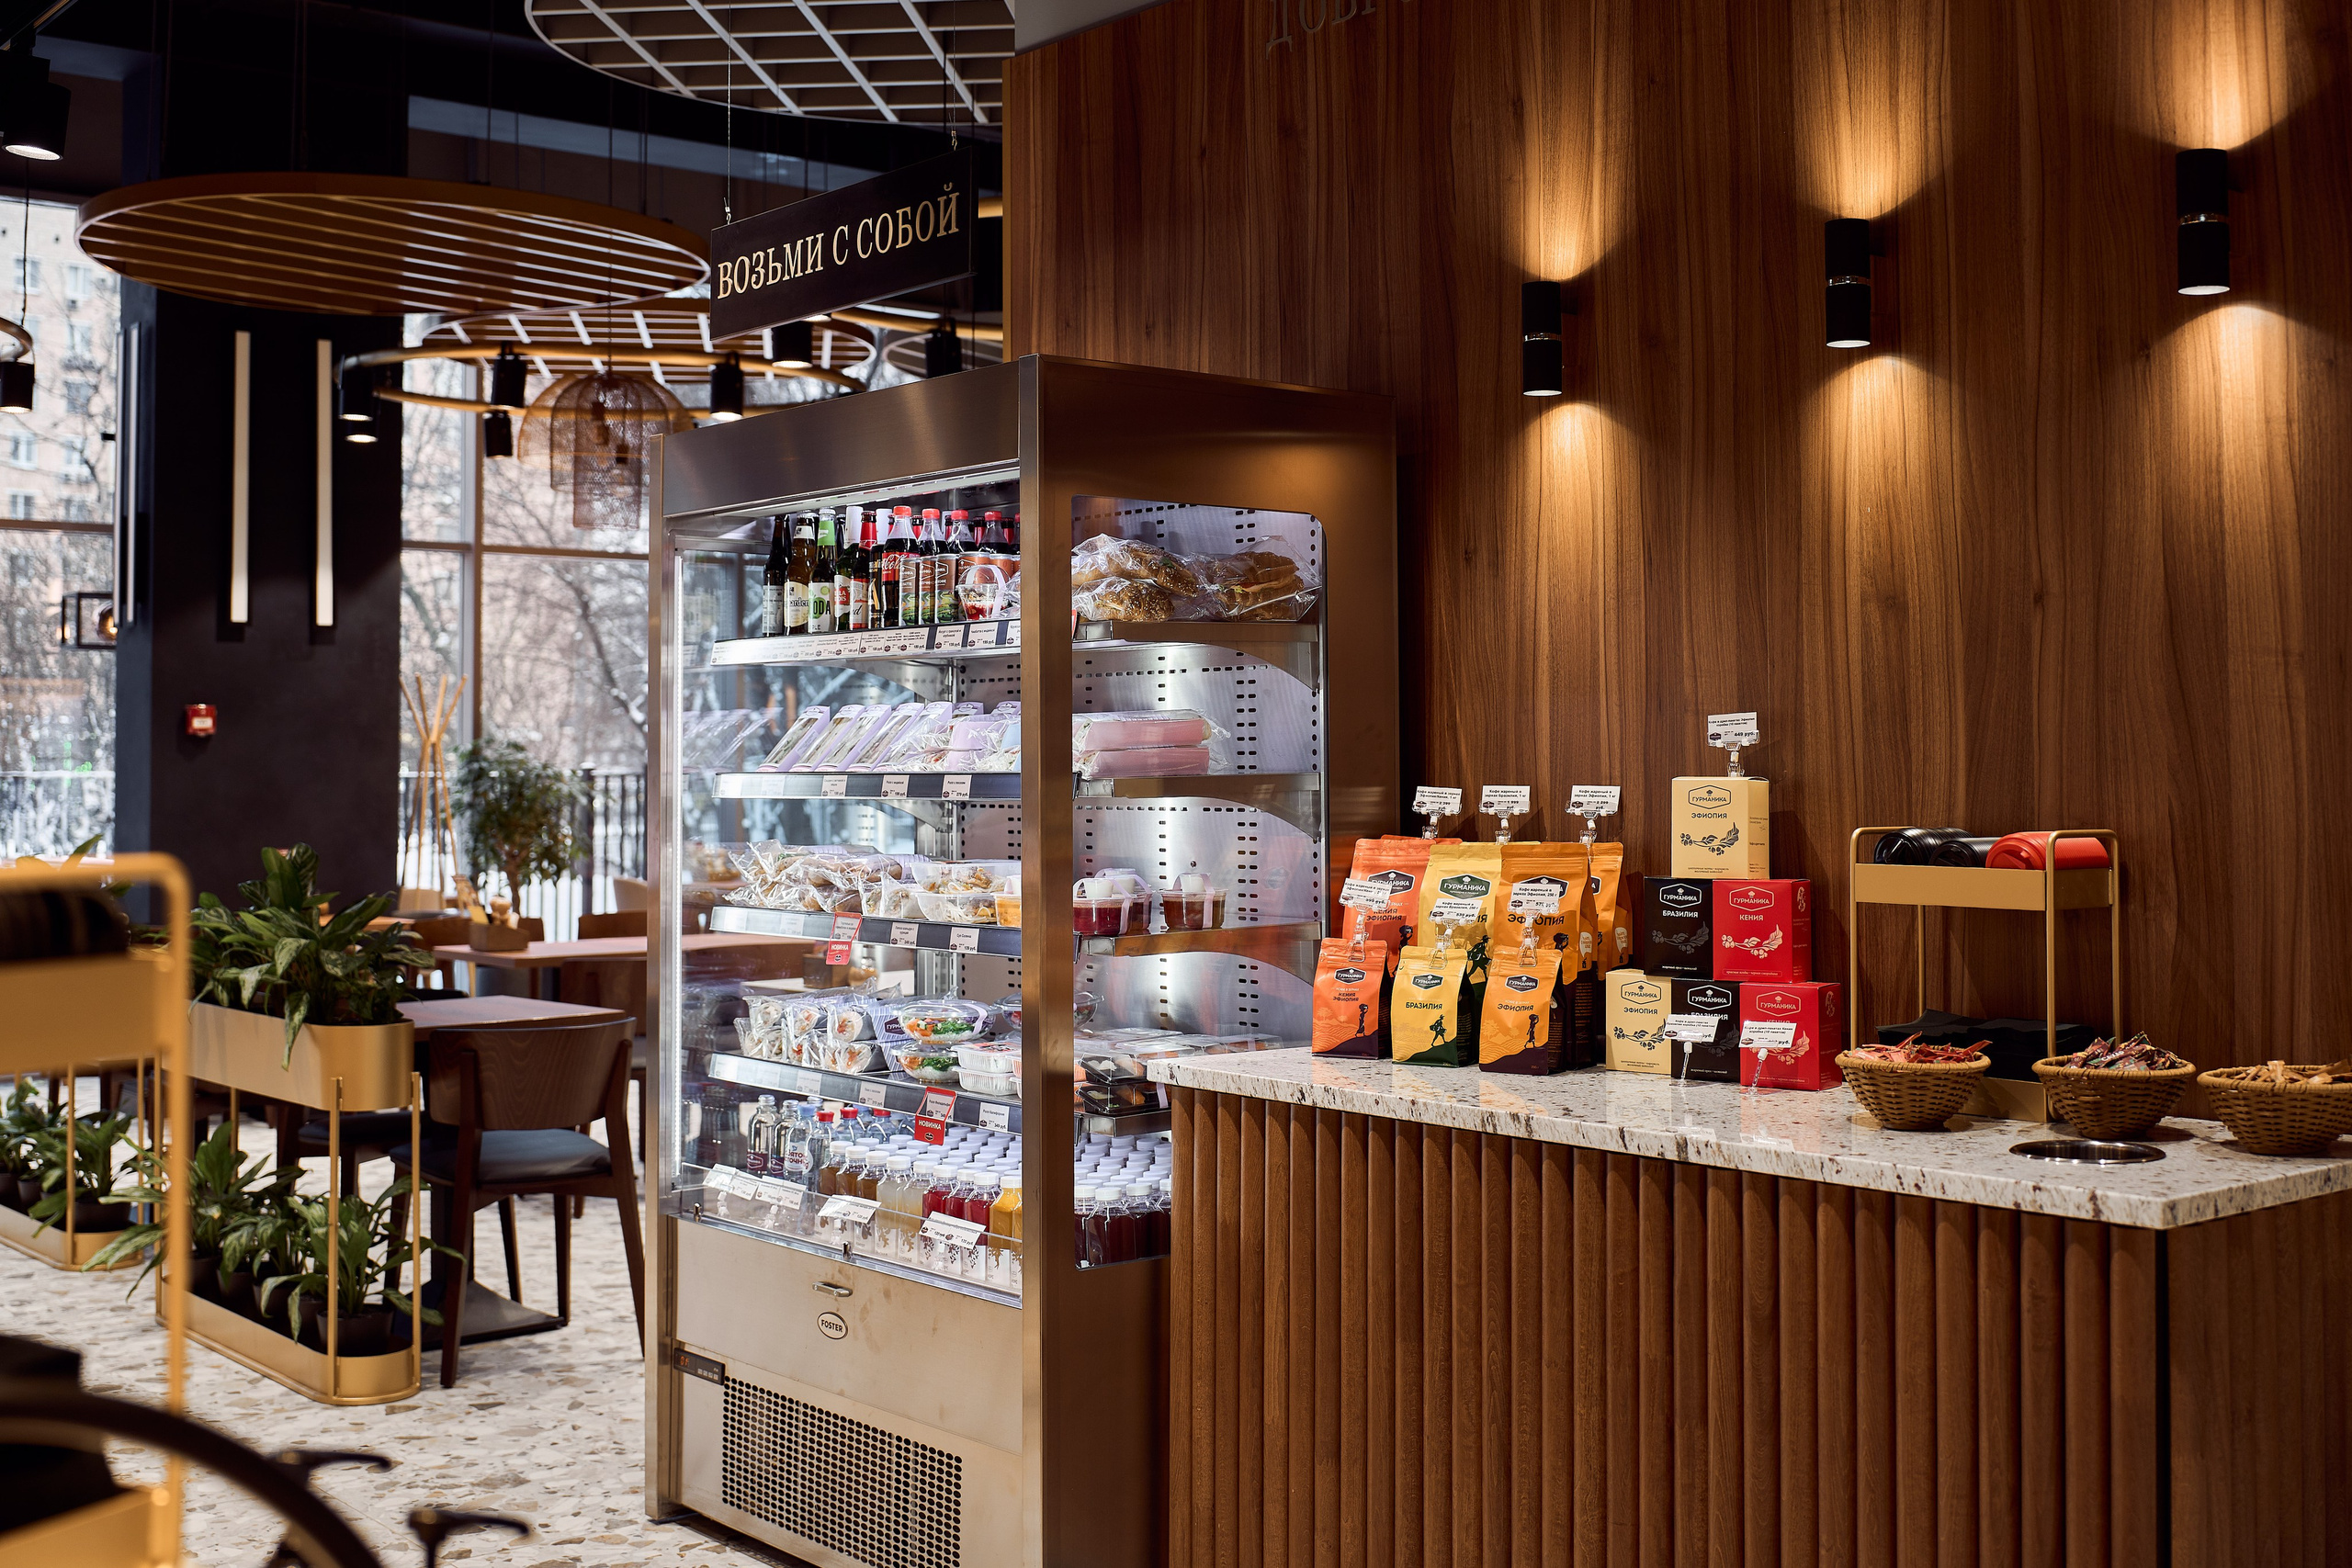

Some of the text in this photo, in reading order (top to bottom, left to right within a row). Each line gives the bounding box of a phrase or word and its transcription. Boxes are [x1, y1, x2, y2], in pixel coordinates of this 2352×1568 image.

[716, 182, 959, 299] ВОЗЬМИ С СОБОЙ
[1443, 883, 1487, 892] ГУРМАНИКА
[1663, 894, 1698, 902] ГУРМАНИКА
[1662, 909, 1699, 919] БРАЗИЛИЯ
[1507, 913, 1565, 927] ЭФОПИЯ
[1624, 990, 1658, 998] ГУРМАНИКА
[1691, 996, 1727, 1004] ГУРМАНИКА
[1406, 1001, 1443, 1010] БРАЗИЛИЯ
[1497, 1003, 1534, 1012] ЭФИОПИЯ
[1760, 1002, 1797, 1010] ГУРМАНИКА
[1623, 1007, 1658, 1015] ЭФИОПИЯ
[918, 1119, 942, 1131] НОВИНКА
[820, 1319, 843, 1333] FOSTER
